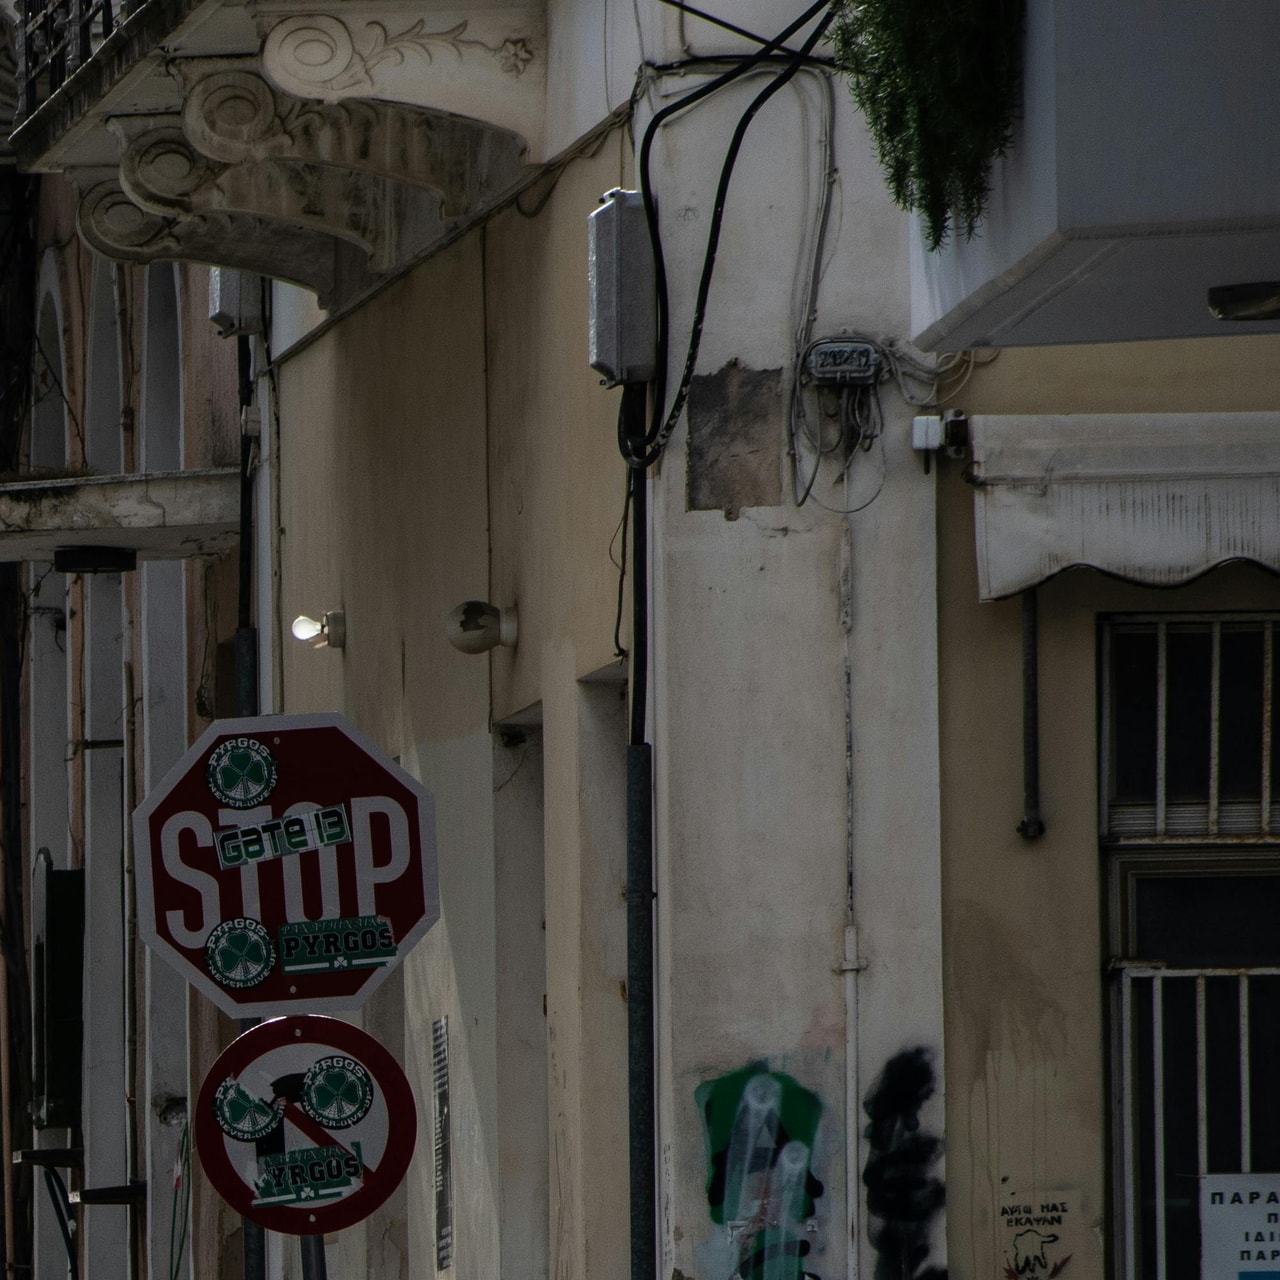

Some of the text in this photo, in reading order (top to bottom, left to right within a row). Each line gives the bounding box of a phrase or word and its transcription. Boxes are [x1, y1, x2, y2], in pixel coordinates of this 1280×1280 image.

[208, 737, 271, 767] PYRGOS
[313, 809, 347, 845] 13
[160, 796, 411, 949] STOP
[207, 917, 269, 949] PYRGOS
[283, 928, 393, 958] PYRGOS
[303, 1056, 365, 1086] PYRGOS
[267, 1156, 361, 1189] YRGOS
[1244, 1231, 1280, 1242] ΙΔΙ
